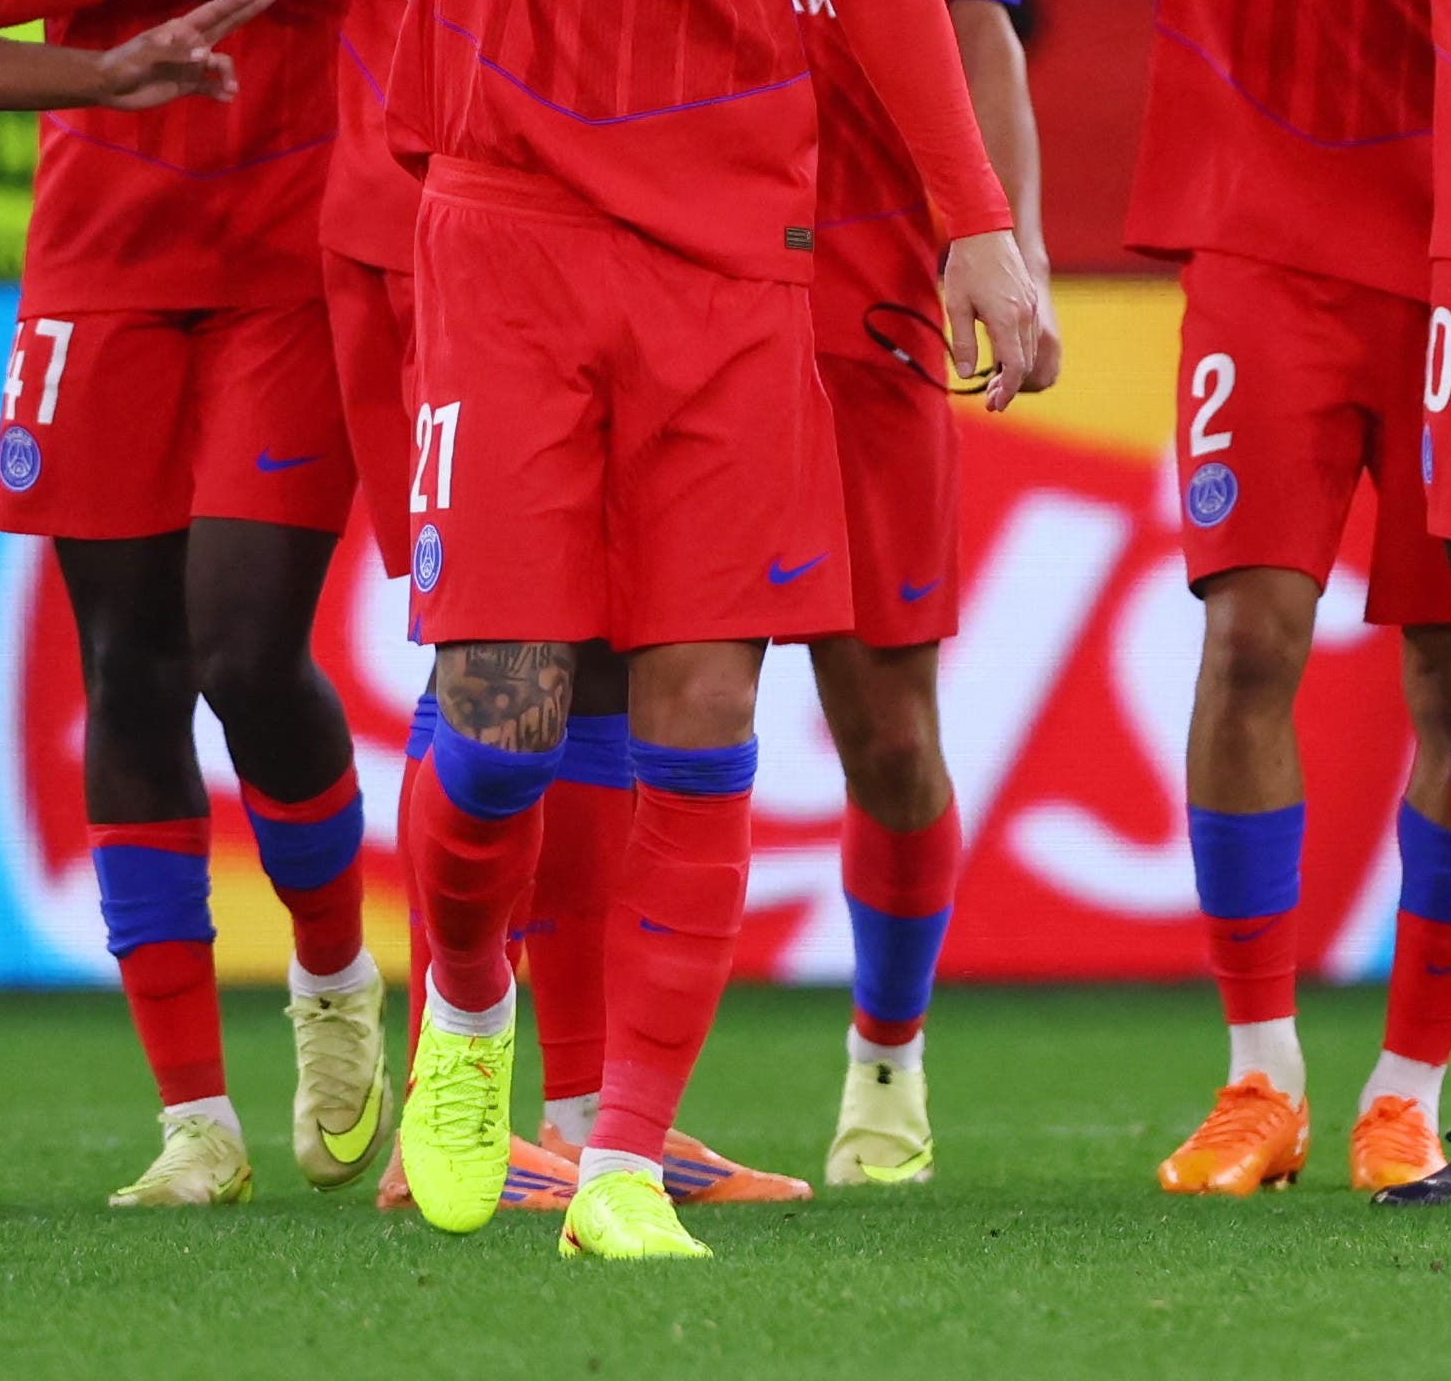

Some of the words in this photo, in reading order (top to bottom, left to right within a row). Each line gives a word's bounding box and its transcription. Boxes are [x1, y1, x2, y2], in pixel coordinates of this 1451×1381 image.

[4, 318, 74, 424] 47
[1190, 353, 1236, 457] 2
[410, 401, 461, 513] 21
